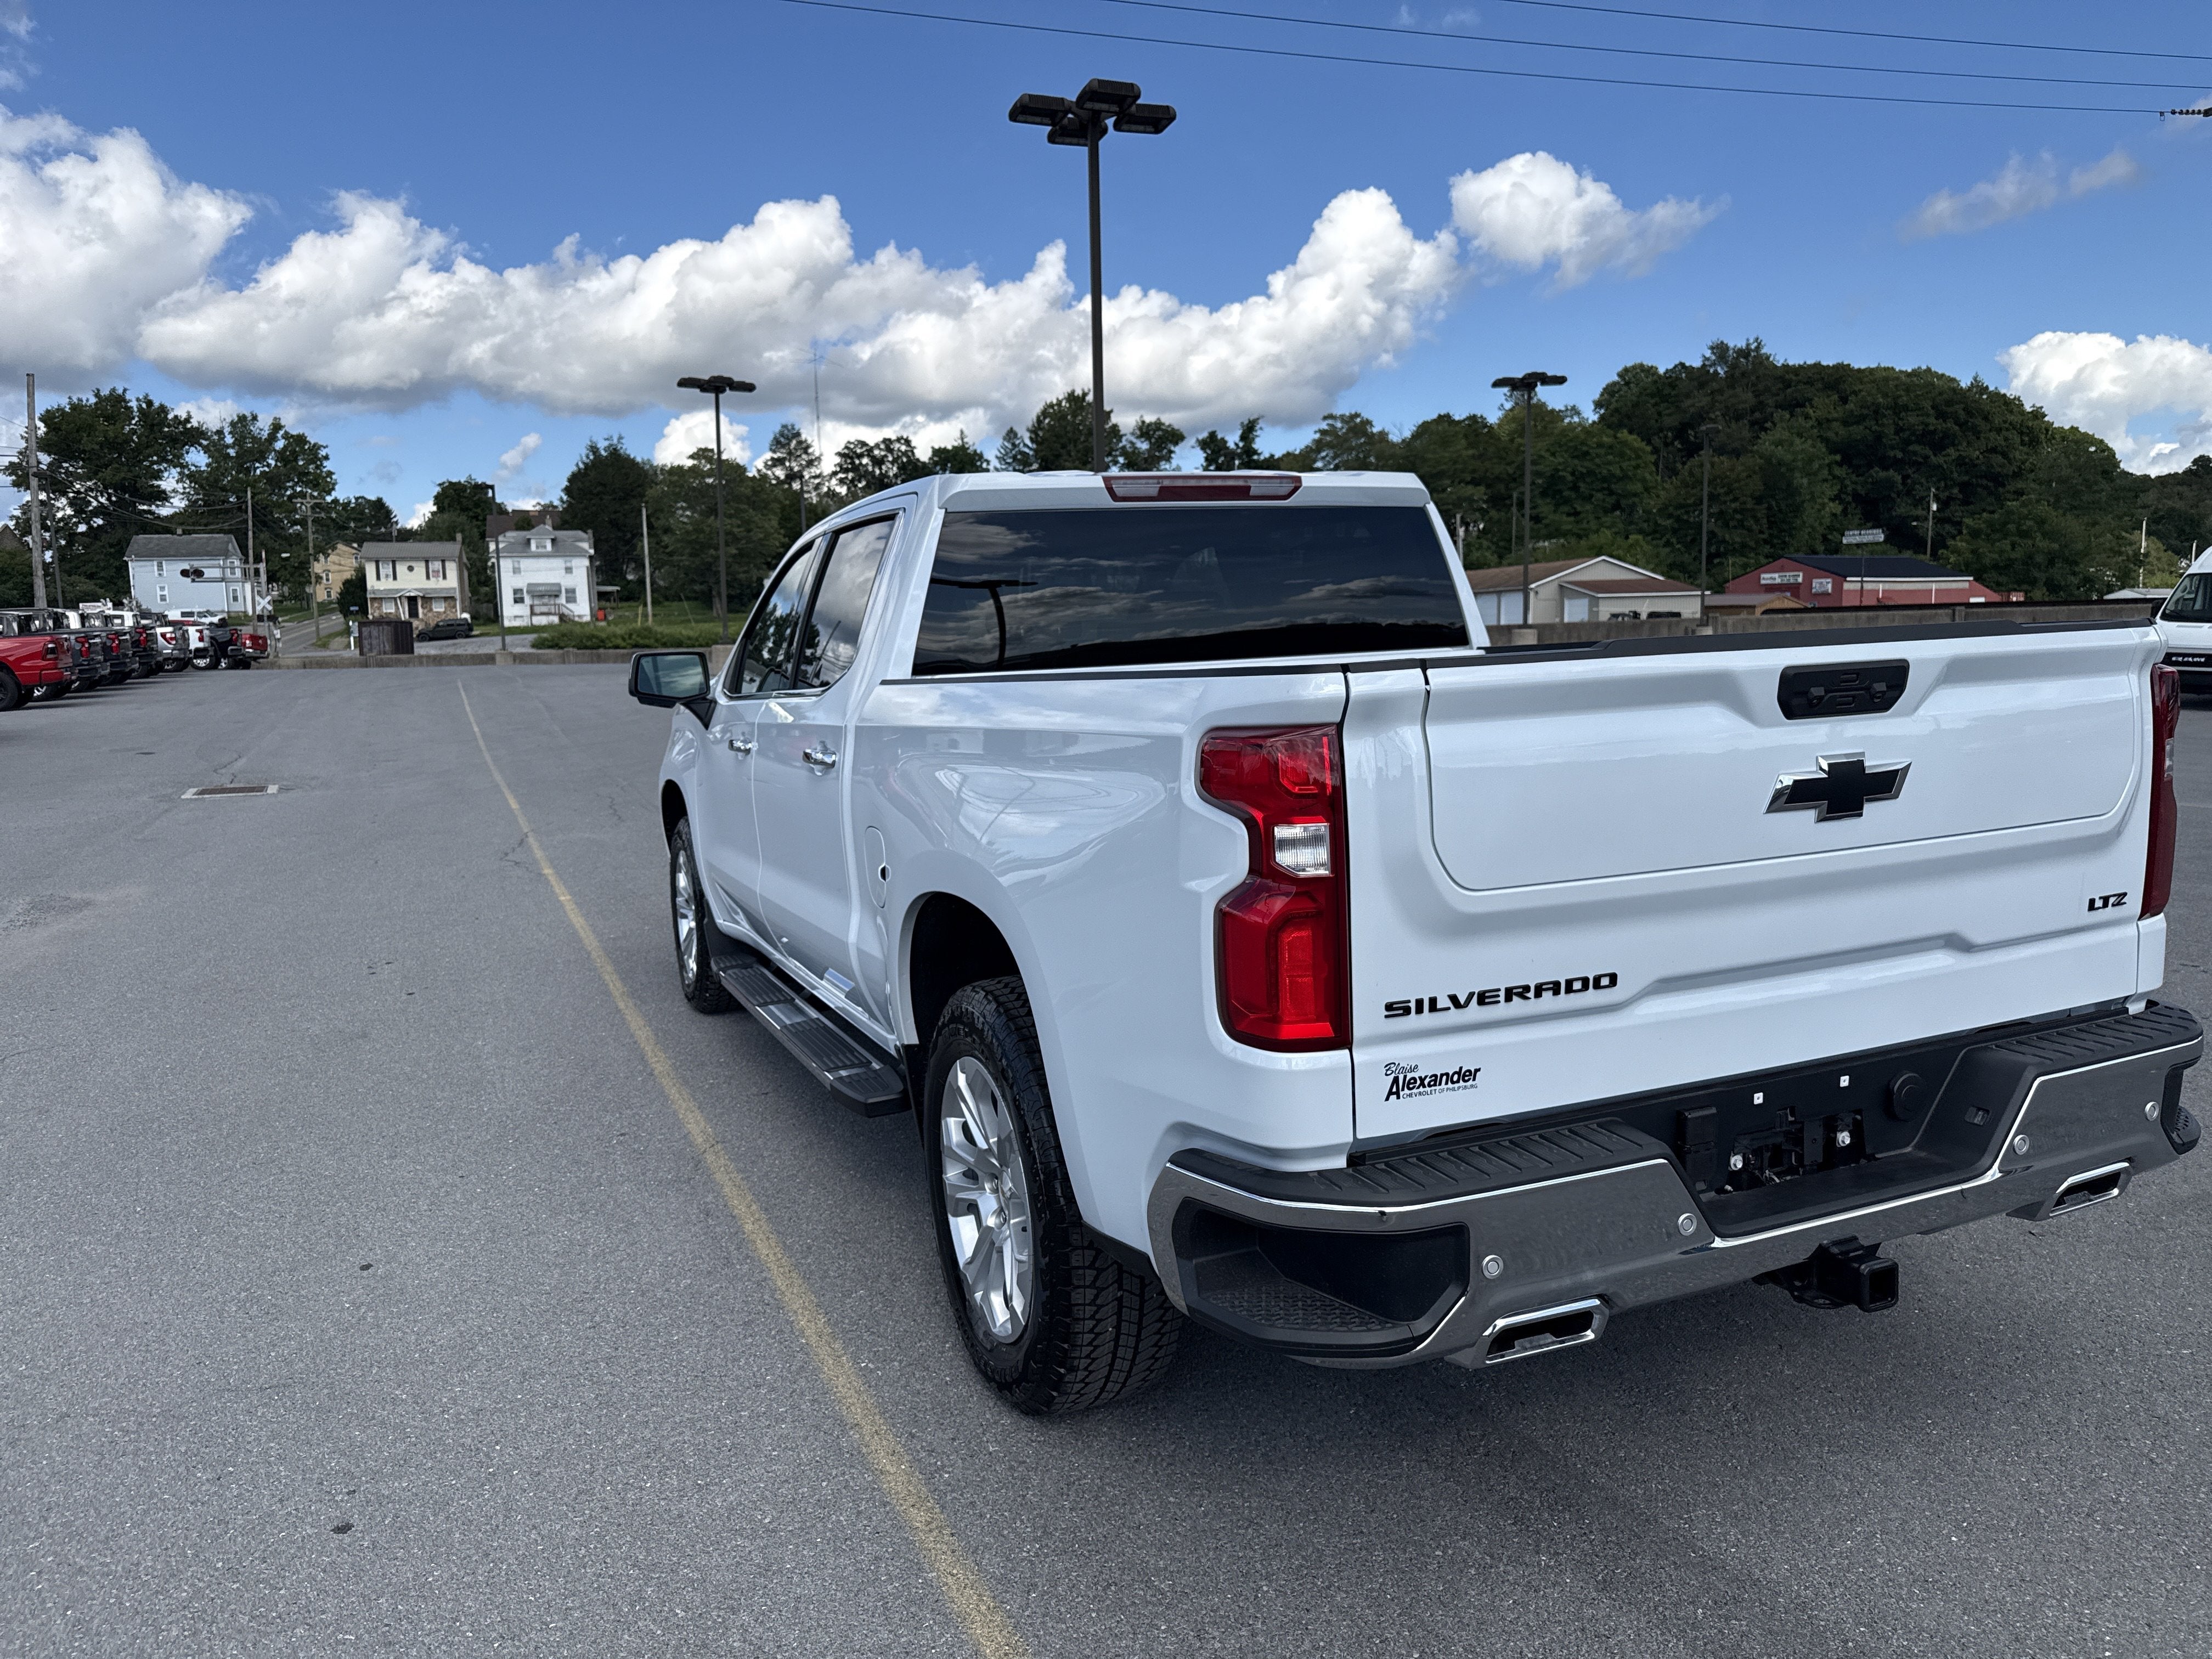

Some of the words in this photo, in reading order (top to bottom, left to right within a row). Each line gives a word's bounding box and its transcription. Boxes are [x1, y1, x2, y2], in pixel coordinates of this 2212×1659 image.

[2087, 891, 2128, 912] LTZ
[1384, 972, 1618, 1019] SILVERADO
[1384, 1062, 1419, 1076] Blaise
[1384, 1066, 1481, 1102] Alexander
[1402, 1088, 1437, 1099] CHEVROLET
[1446, 1083, 1478, 1092] PHILIPSBURG
